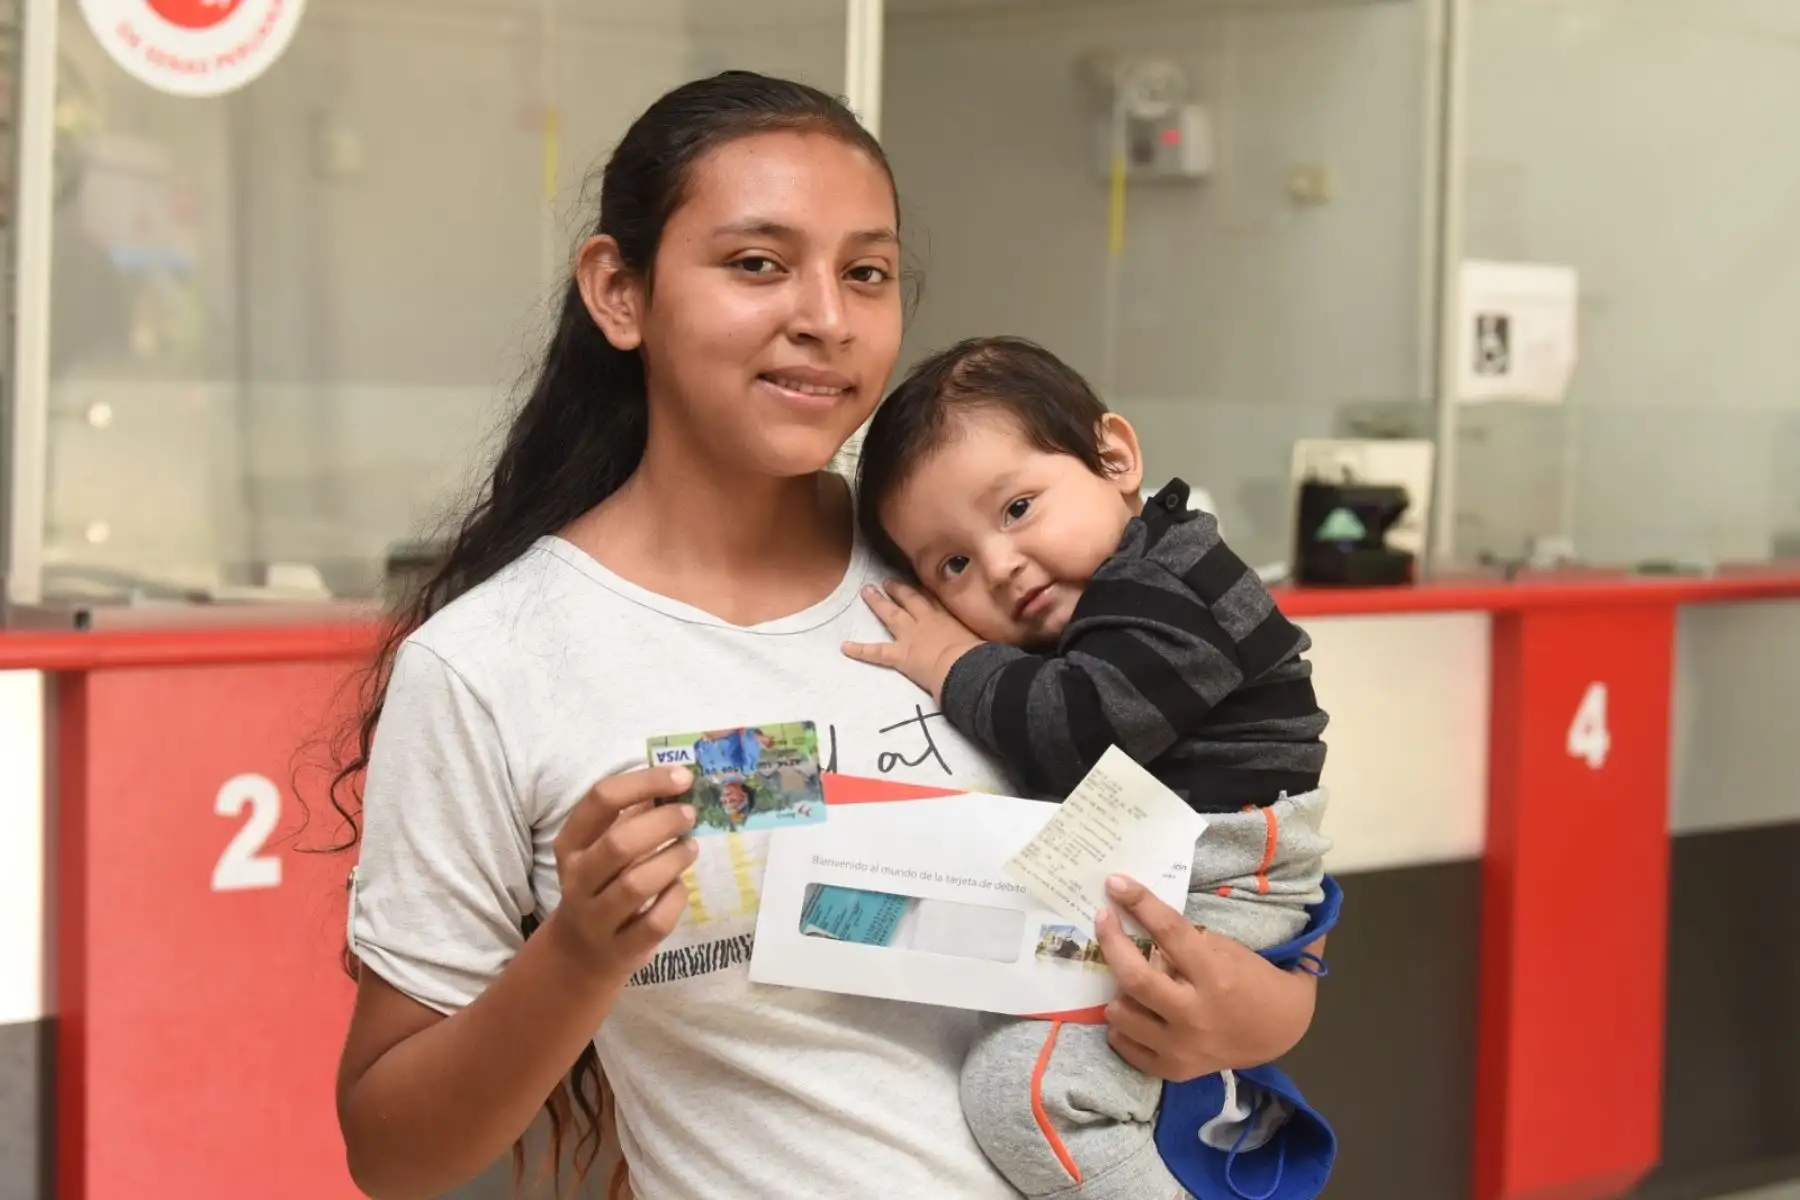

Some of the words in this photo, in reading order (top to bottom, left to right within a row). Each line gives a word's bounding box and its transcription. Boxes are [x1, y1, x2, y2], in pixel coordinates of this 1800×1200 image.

[656, 749, 690, 763] VISA
[1566, 681, 1610, 769] 4
[210, 772, 283, 892] 2
[811, 854, 868, 872] Bienvenido
[870, 861, 880, 874] al
[881, 865, 918, 879] mundo
[919, 870, 933, 882] de
[934, 871, 943, 882] la
[945, 874, 977, 887] tarjeta
[978, 878, 992, 890] de
